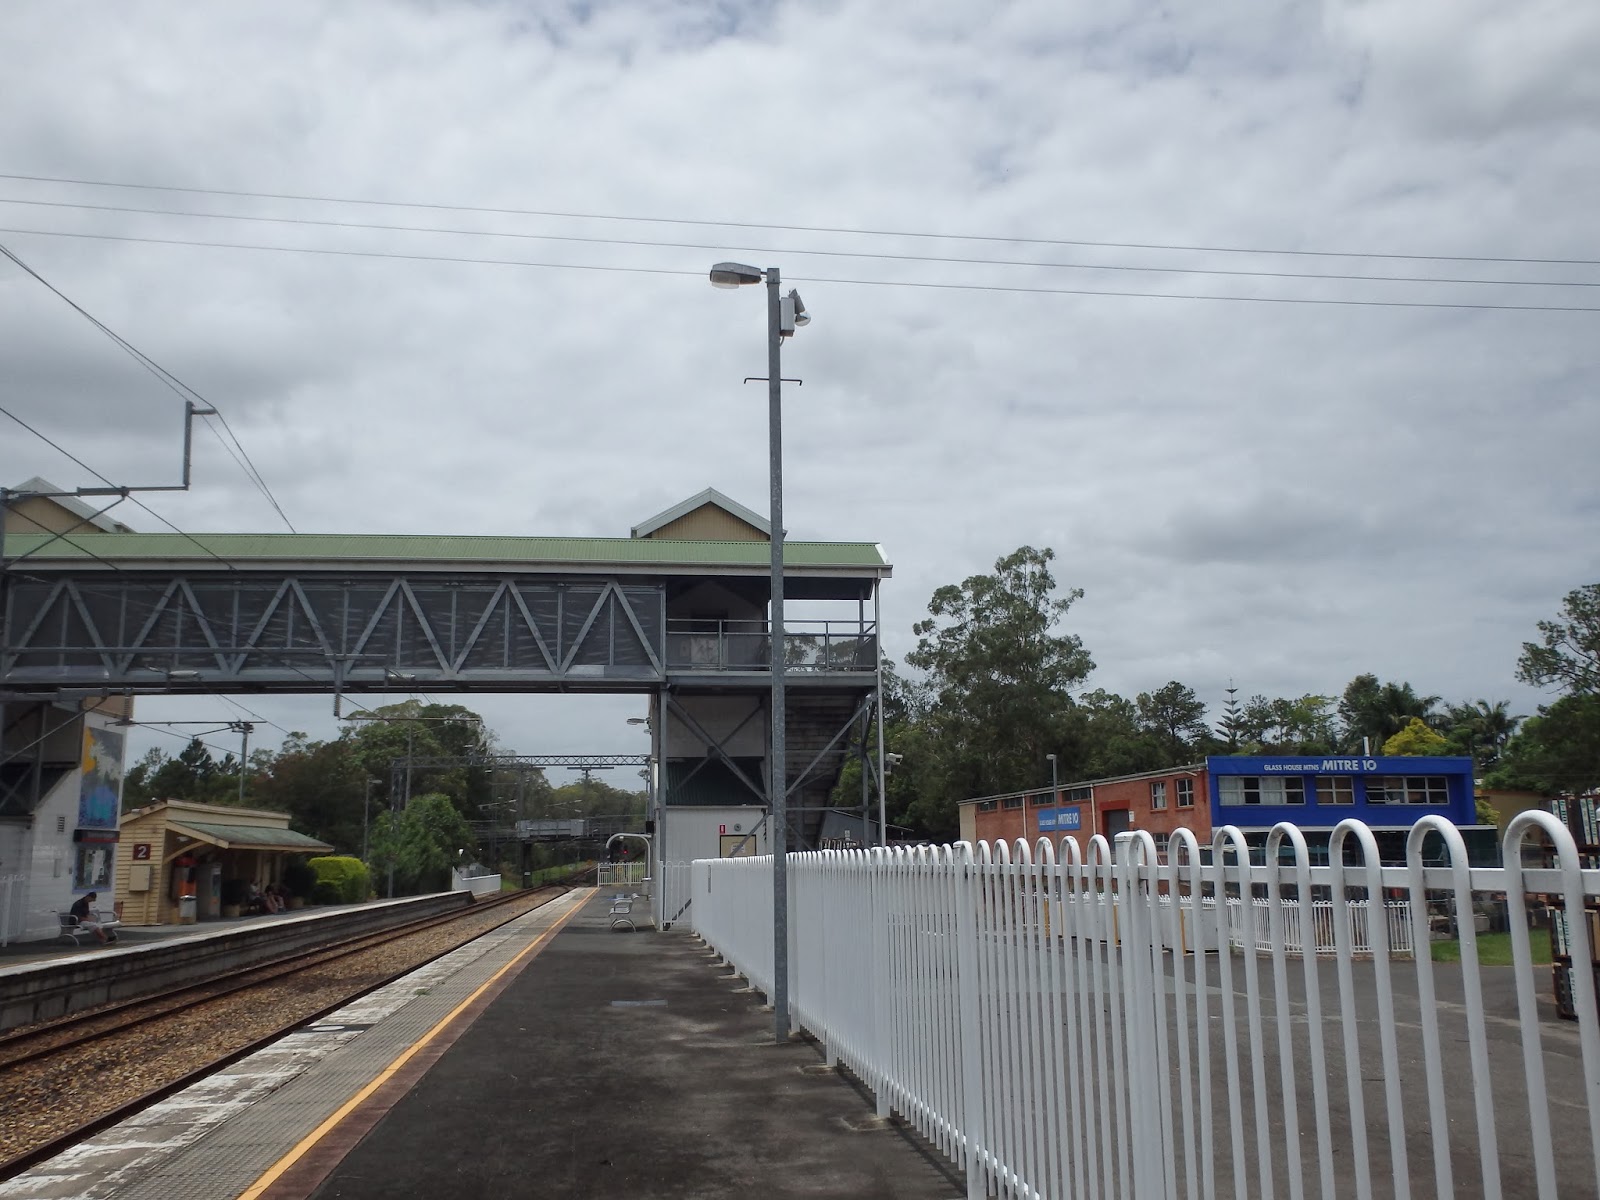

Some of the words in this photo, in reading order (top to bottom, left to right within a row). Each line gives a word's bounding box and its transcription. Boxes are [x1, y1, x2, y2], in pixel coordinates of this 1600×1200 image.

[1322, 760, 1359, 771] MITRE
[1362, 760, 1377, 771] 10
[1058, 813, 1072, 825] MITRE
[137, 845, 147, 858] 2
